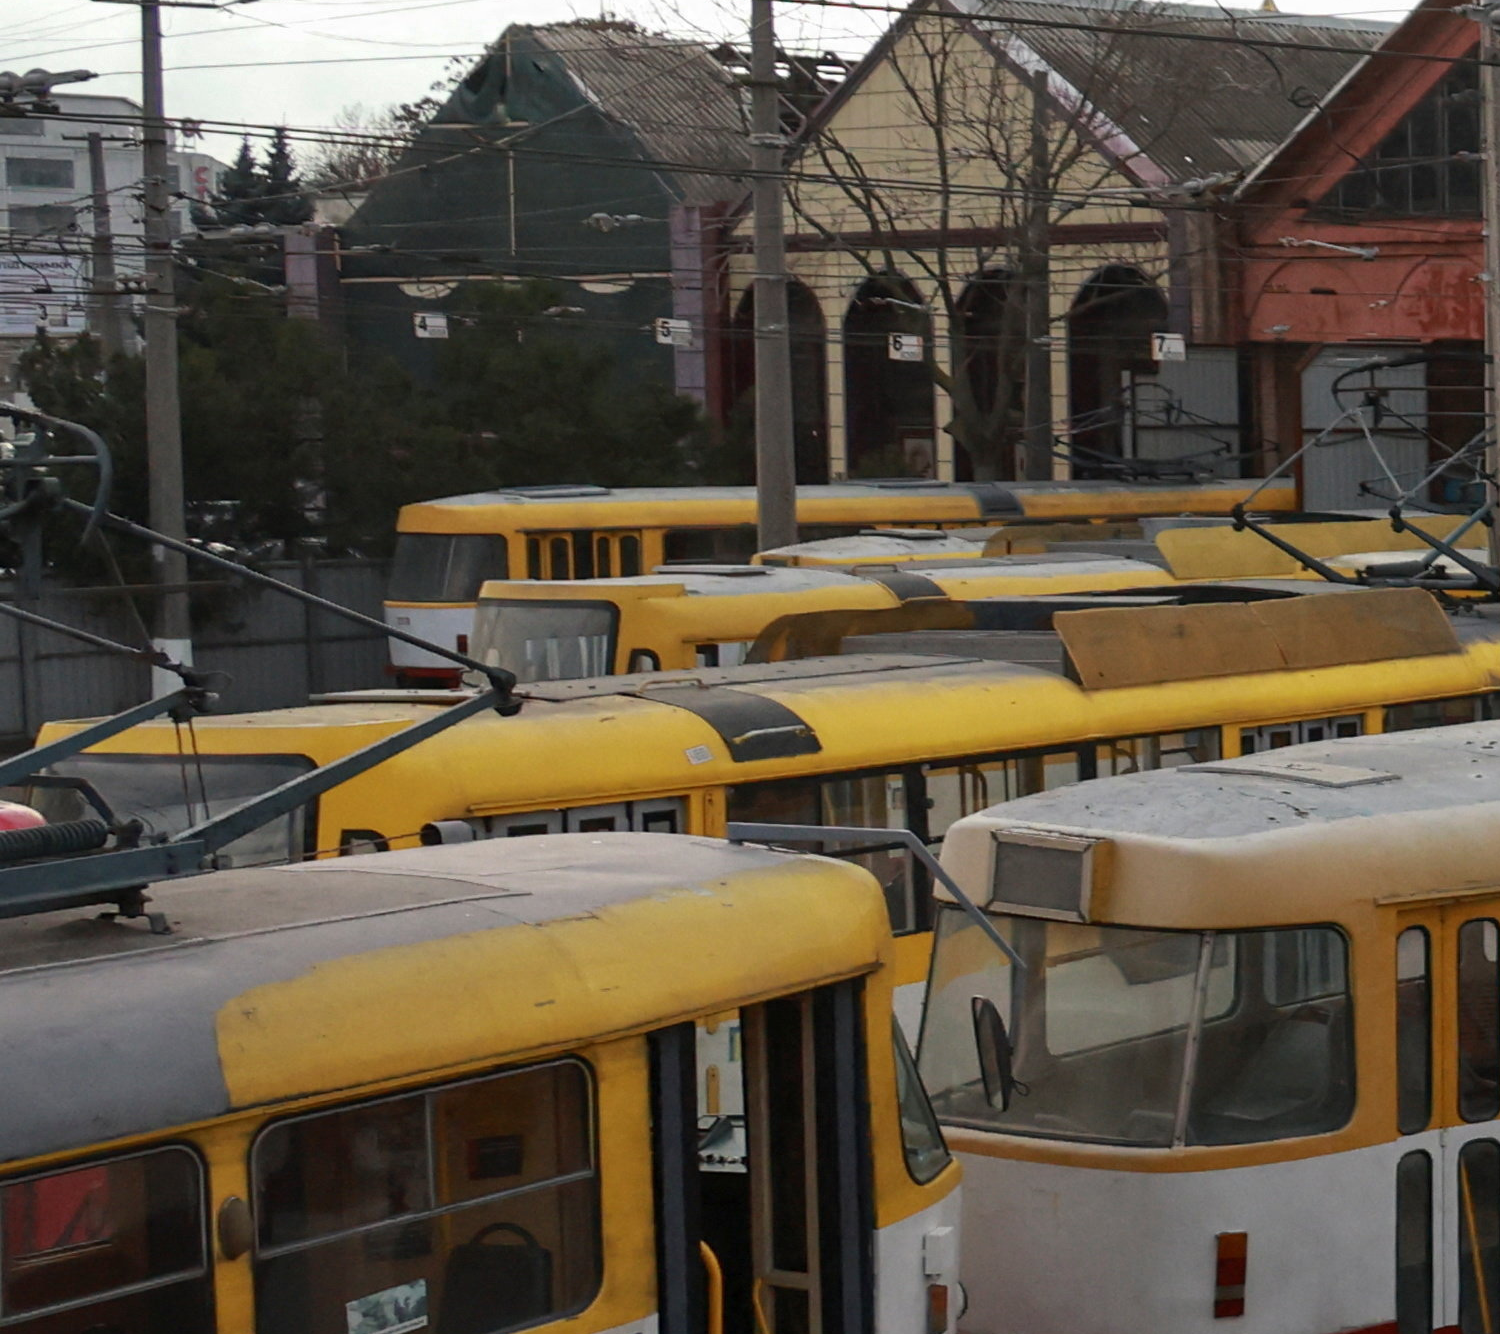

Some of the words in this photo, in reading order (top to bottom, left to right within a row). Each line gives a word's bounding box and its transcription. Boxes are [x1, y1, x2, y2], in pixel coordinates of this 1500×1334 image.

[418, 316, 428, 331] 4
[661, 321, 671, 337] 5
[893, 335, 903, 351] 6
[1156, 335, 1166, 353] 7
